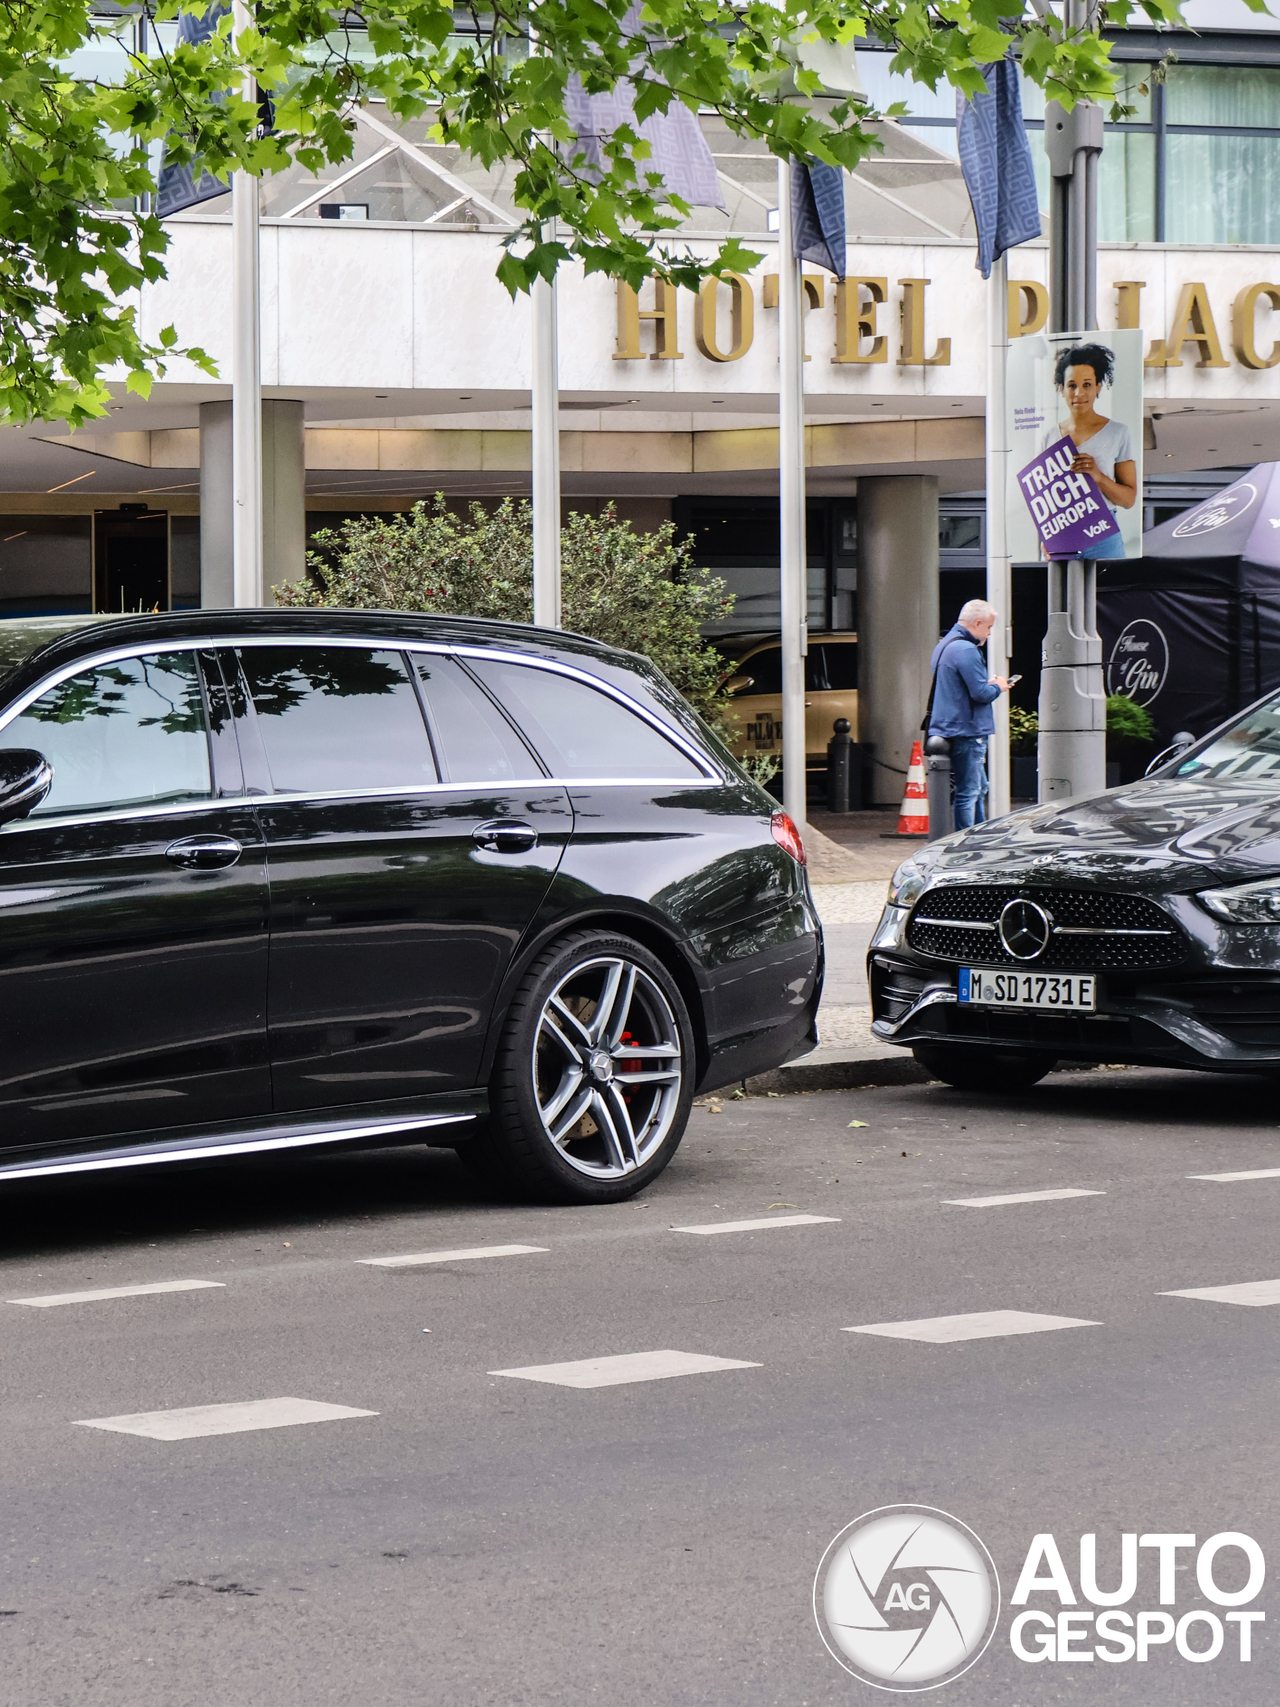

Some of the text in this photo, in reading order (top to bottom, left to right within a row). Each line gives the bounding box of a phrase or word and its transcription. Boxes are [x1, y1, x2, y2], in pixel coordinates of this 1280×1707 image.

[1008, 280, 1280, 370] PLAC
[1021, 445, 1075, 497] TRAU
[1030, 472, 1092, 524] DICH
[1040, 497, 1100, 540] EUROPA
[1083, 519, 1111, 538] Volt
[1116, 658, 1159, 699] Gin
[971, 973, 982, 999] M
